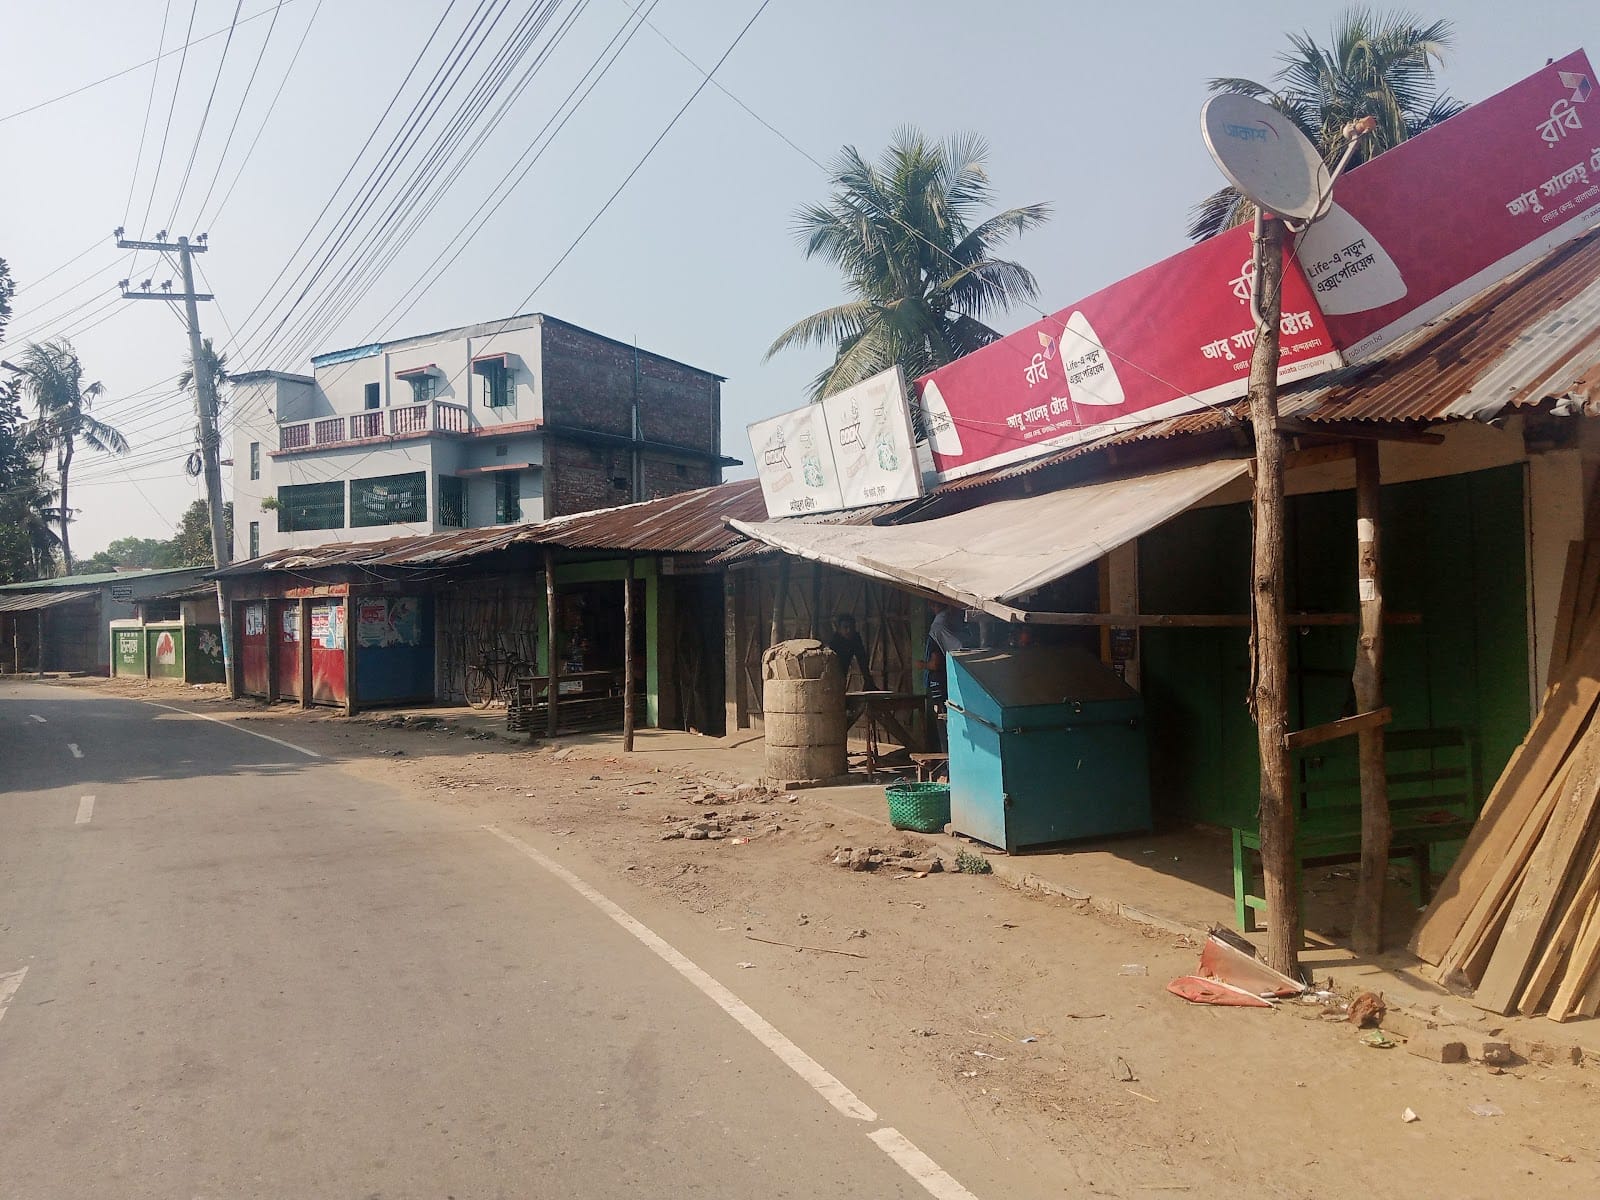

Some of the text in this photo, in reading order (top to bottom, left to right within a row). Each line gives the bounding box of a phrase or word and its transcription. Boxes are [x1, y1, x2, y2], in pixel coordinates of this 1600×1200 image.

[1535, 98, 1582, 149] রবি
[1506, 189, 1544, 217] আবু
[1307, 238, 1367, 278] Life-এ নতুন
[1200, 338, 1236, 361] আবু
[1024, 352, 1049, 388] রবি
[1297, 359, 1326, 373] company
[1006, 412, 1026, 431] আবু
